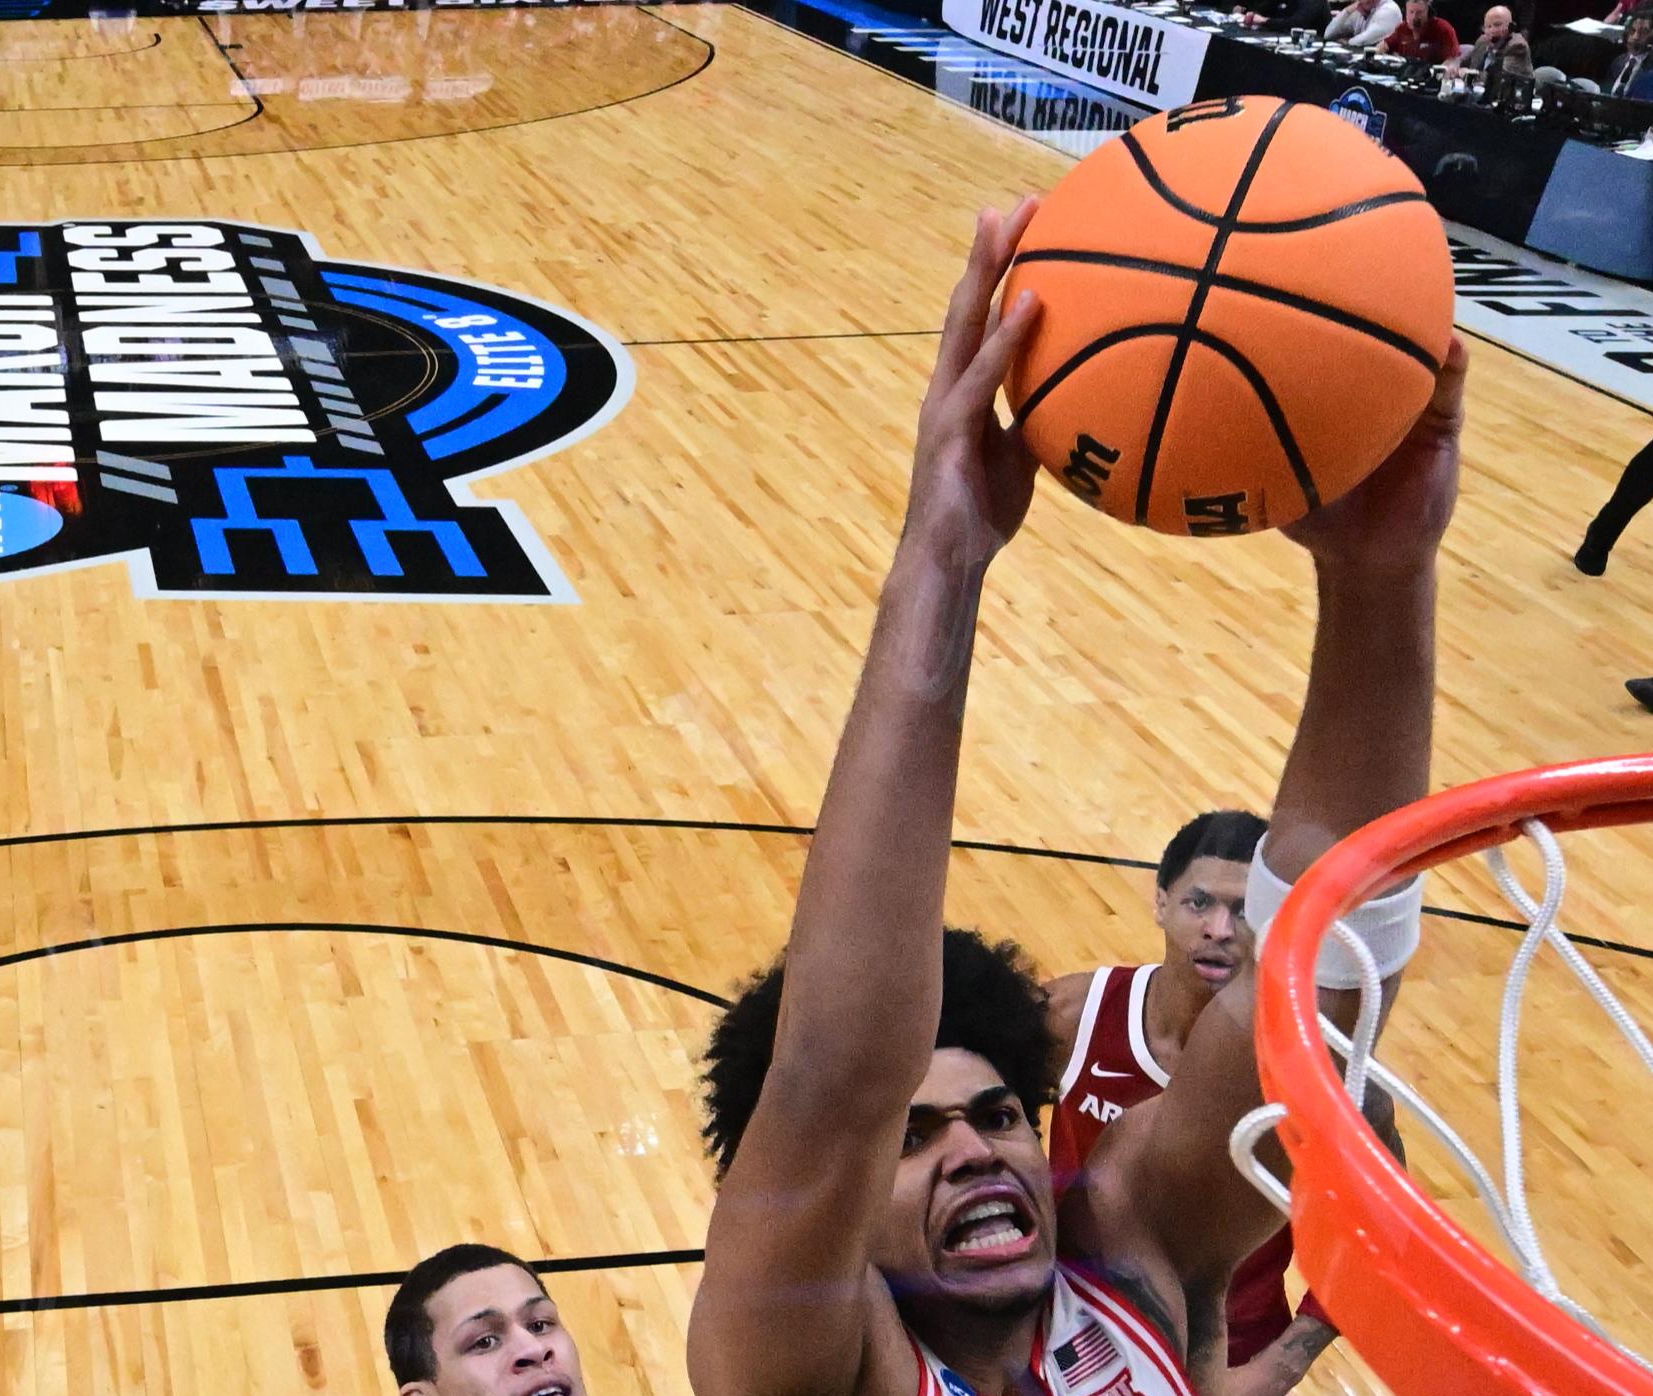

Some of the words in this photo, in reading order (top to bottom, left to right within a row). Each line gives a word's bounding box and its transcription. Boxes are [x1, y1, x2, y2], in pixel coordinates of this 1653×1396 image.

[979, 0, 1043, 48] WEST
[1043, 2, 1165, 95] REGIONAL
[62, 224, 317, 443] MADNESS
[458, 331, 544, 390] ELITE
[1568, 329, 1632, 344] TO
